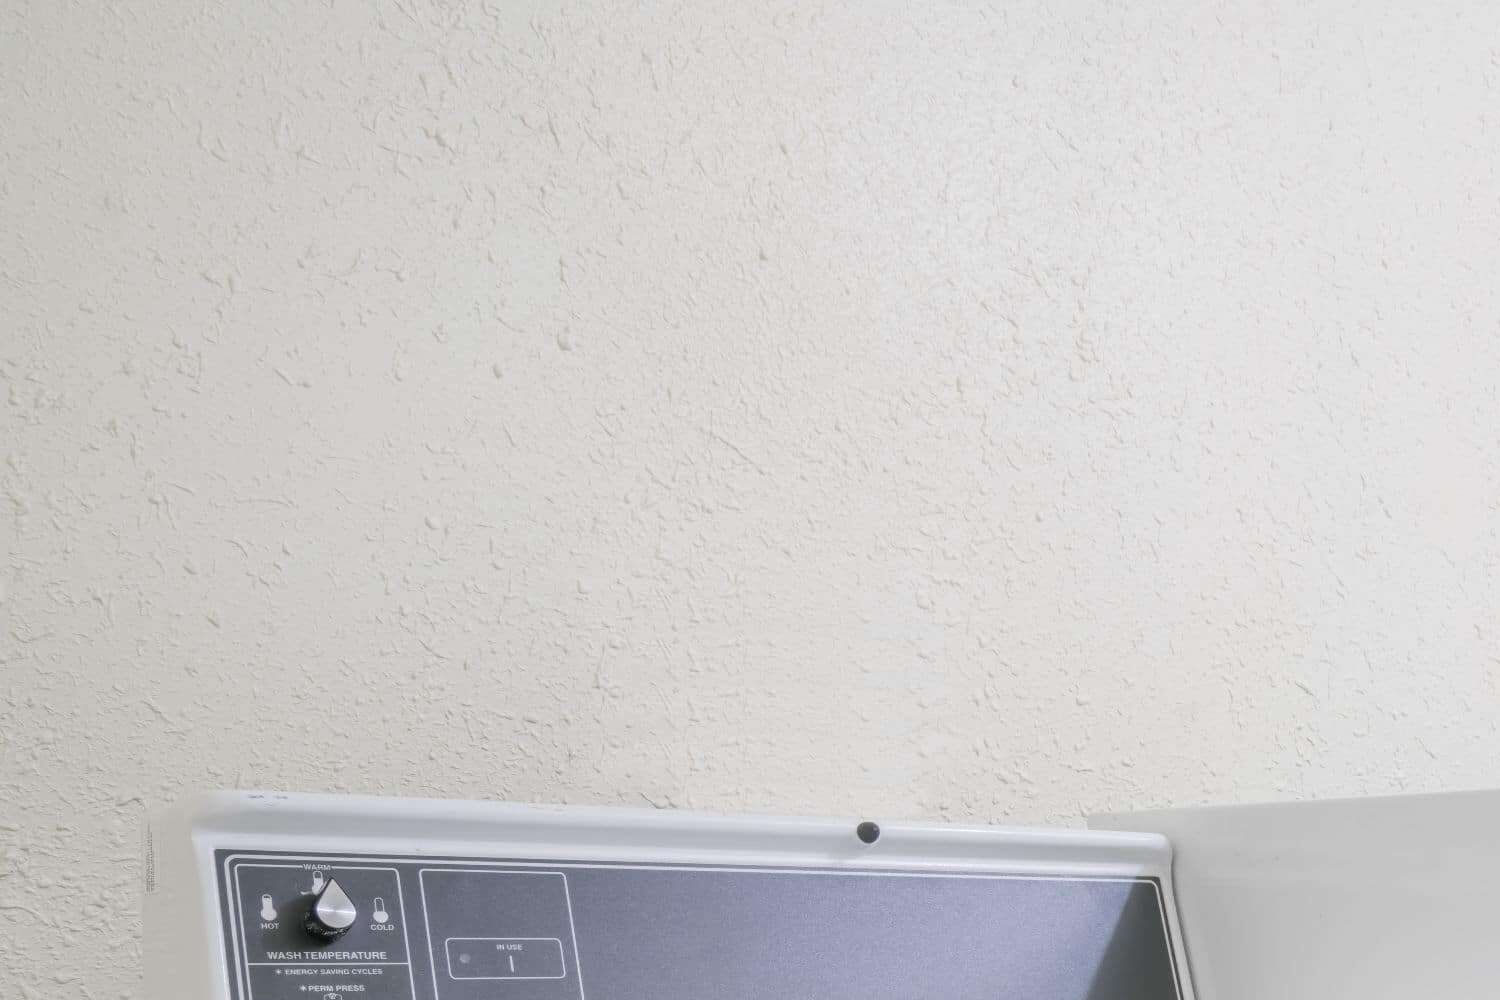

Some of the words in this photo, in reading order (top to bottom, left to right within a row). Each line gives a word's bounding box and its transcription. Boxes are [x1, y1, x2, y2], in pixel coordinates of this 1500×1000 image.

[303, 863, 331, 871] WARM
[506, 943, 523, 951] USE
[266, 951, 302, 960] WASH
[304, 951, 387, 960] TEMPERATURE
